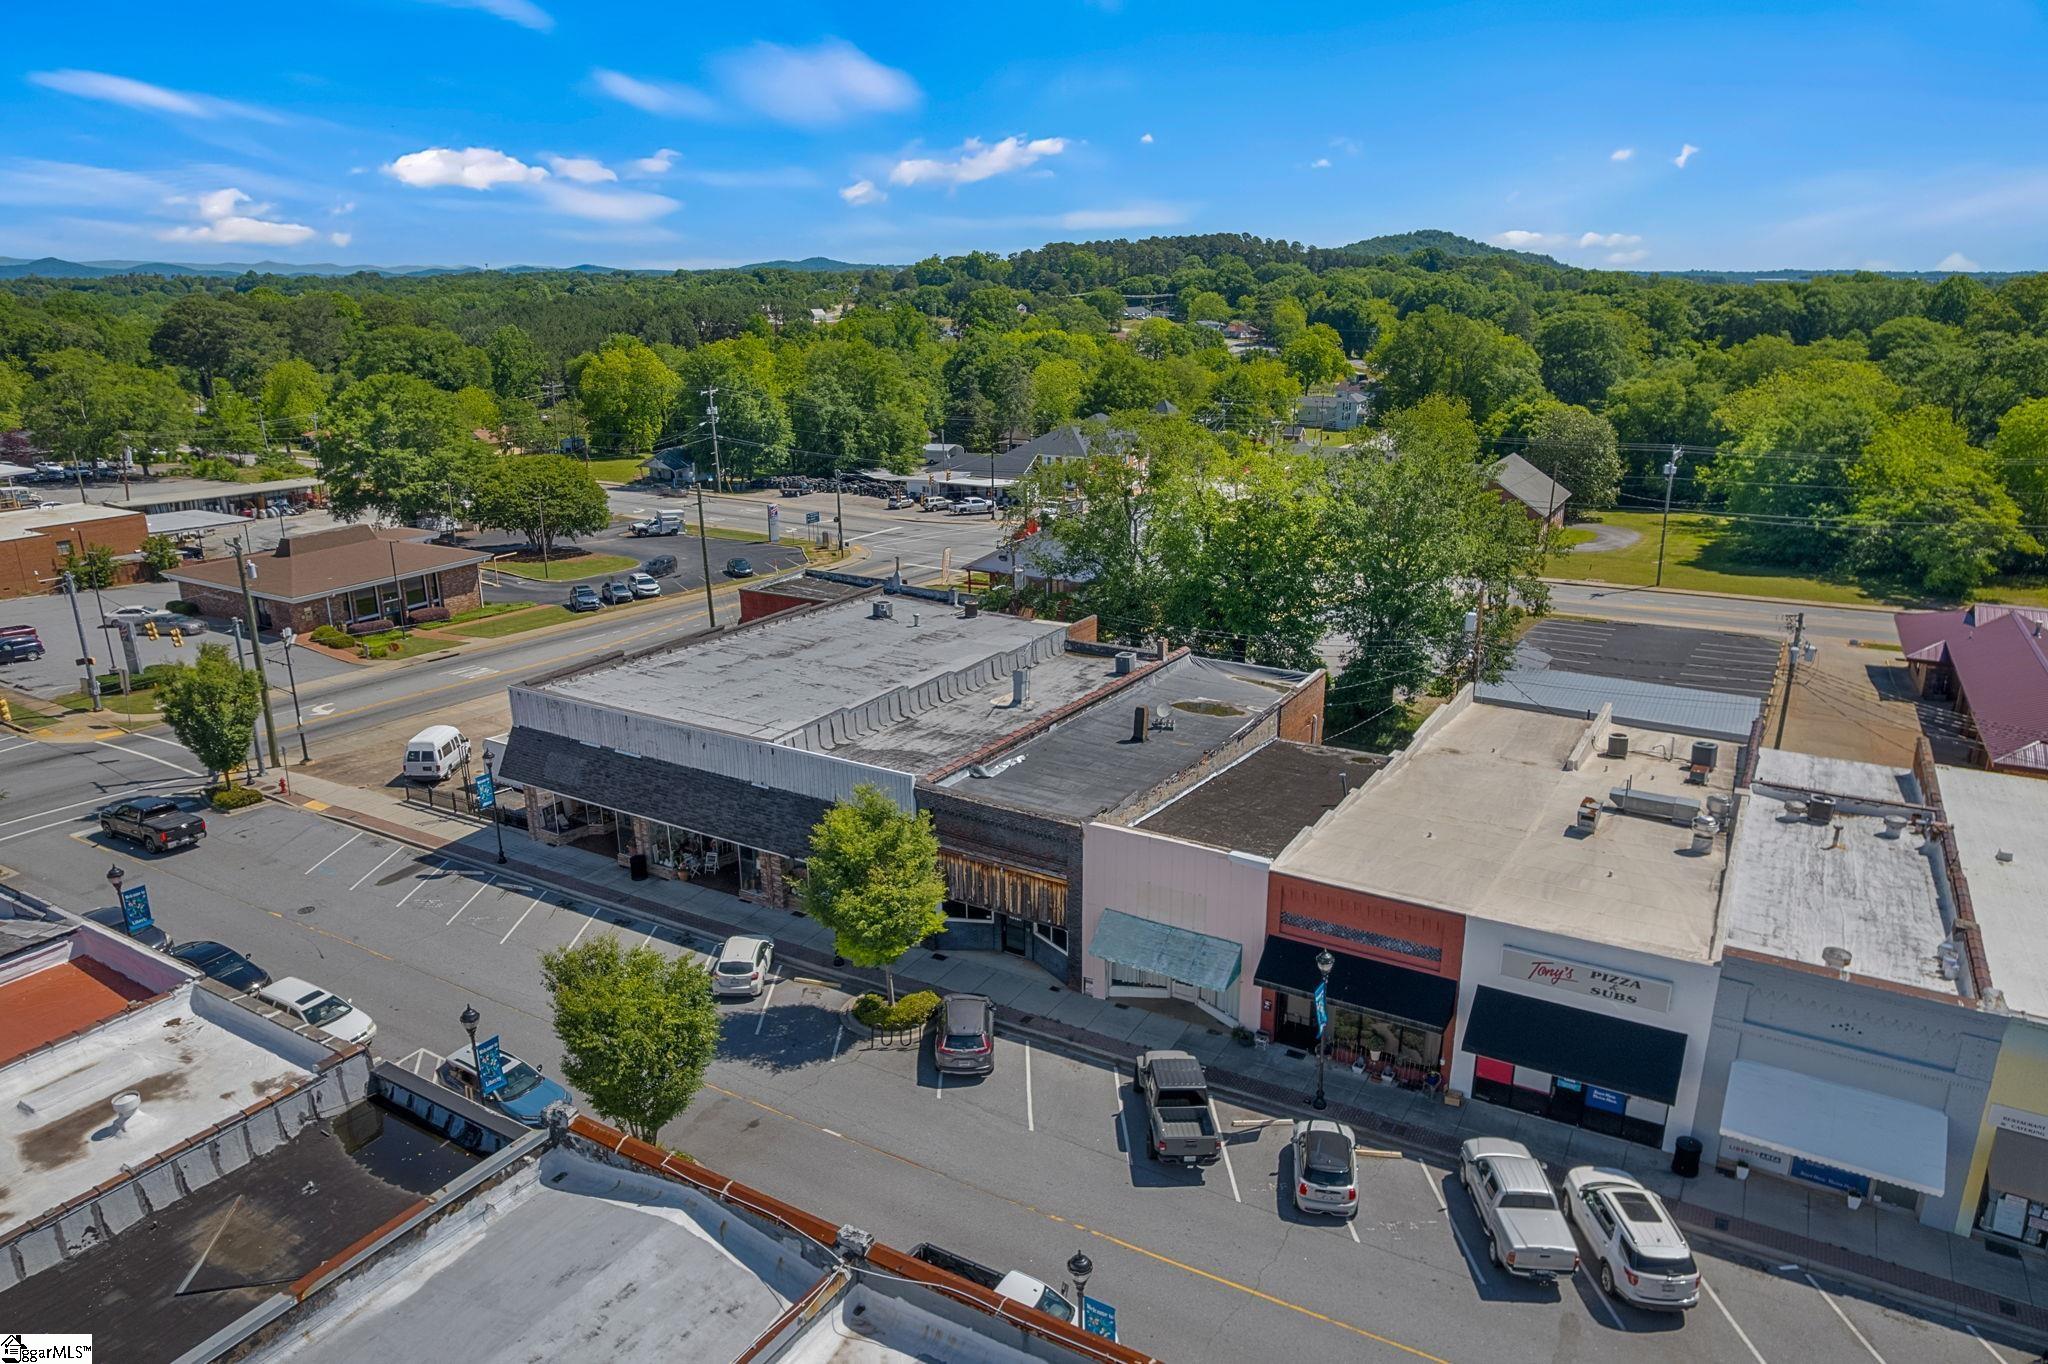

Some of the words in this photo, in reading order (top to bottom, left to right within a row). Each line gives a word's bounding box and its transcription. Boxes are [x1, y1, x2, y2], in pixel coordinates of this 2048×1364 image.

[1528, 962, 1578, 985] Tony's
[1590, 970, 1641, 990] PIZZA
[1589, 986, 1638, 1004] SUBS
